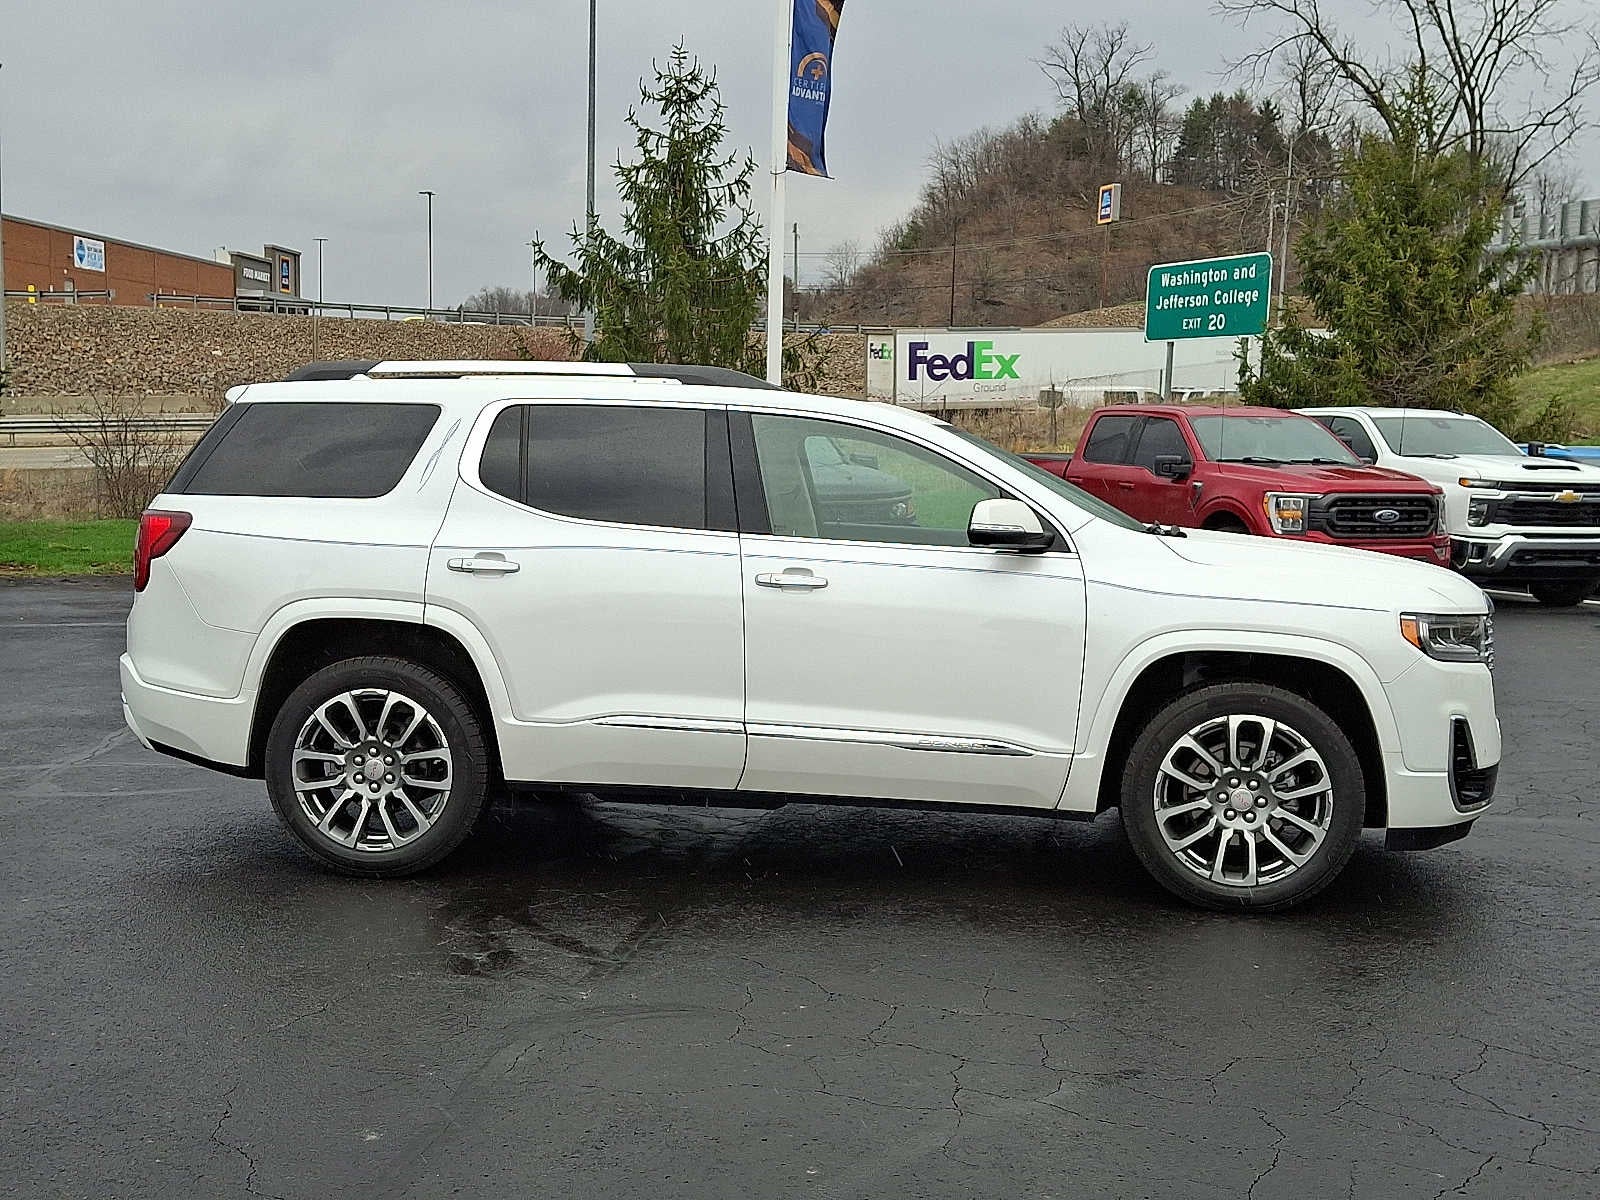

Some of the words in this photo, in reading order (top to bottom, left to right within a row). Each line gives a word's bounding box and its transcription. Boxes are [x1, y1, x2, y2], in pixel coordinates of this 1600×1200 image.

[1161, 268, 1228, 287] Washington
[1233, 263, 1256, 280] and
[1155, 294, 1209, 310] Jefferson
[1214, 289, 1259, 307] College
[1182, 317, 1201, 330] EXIT
[1207, 313, 1226, 331] 20
[869, 342, 893, 360] FedEx
[908, 340, 1021, 381] FedEx
[973, 382, 1007, 393] Ground
